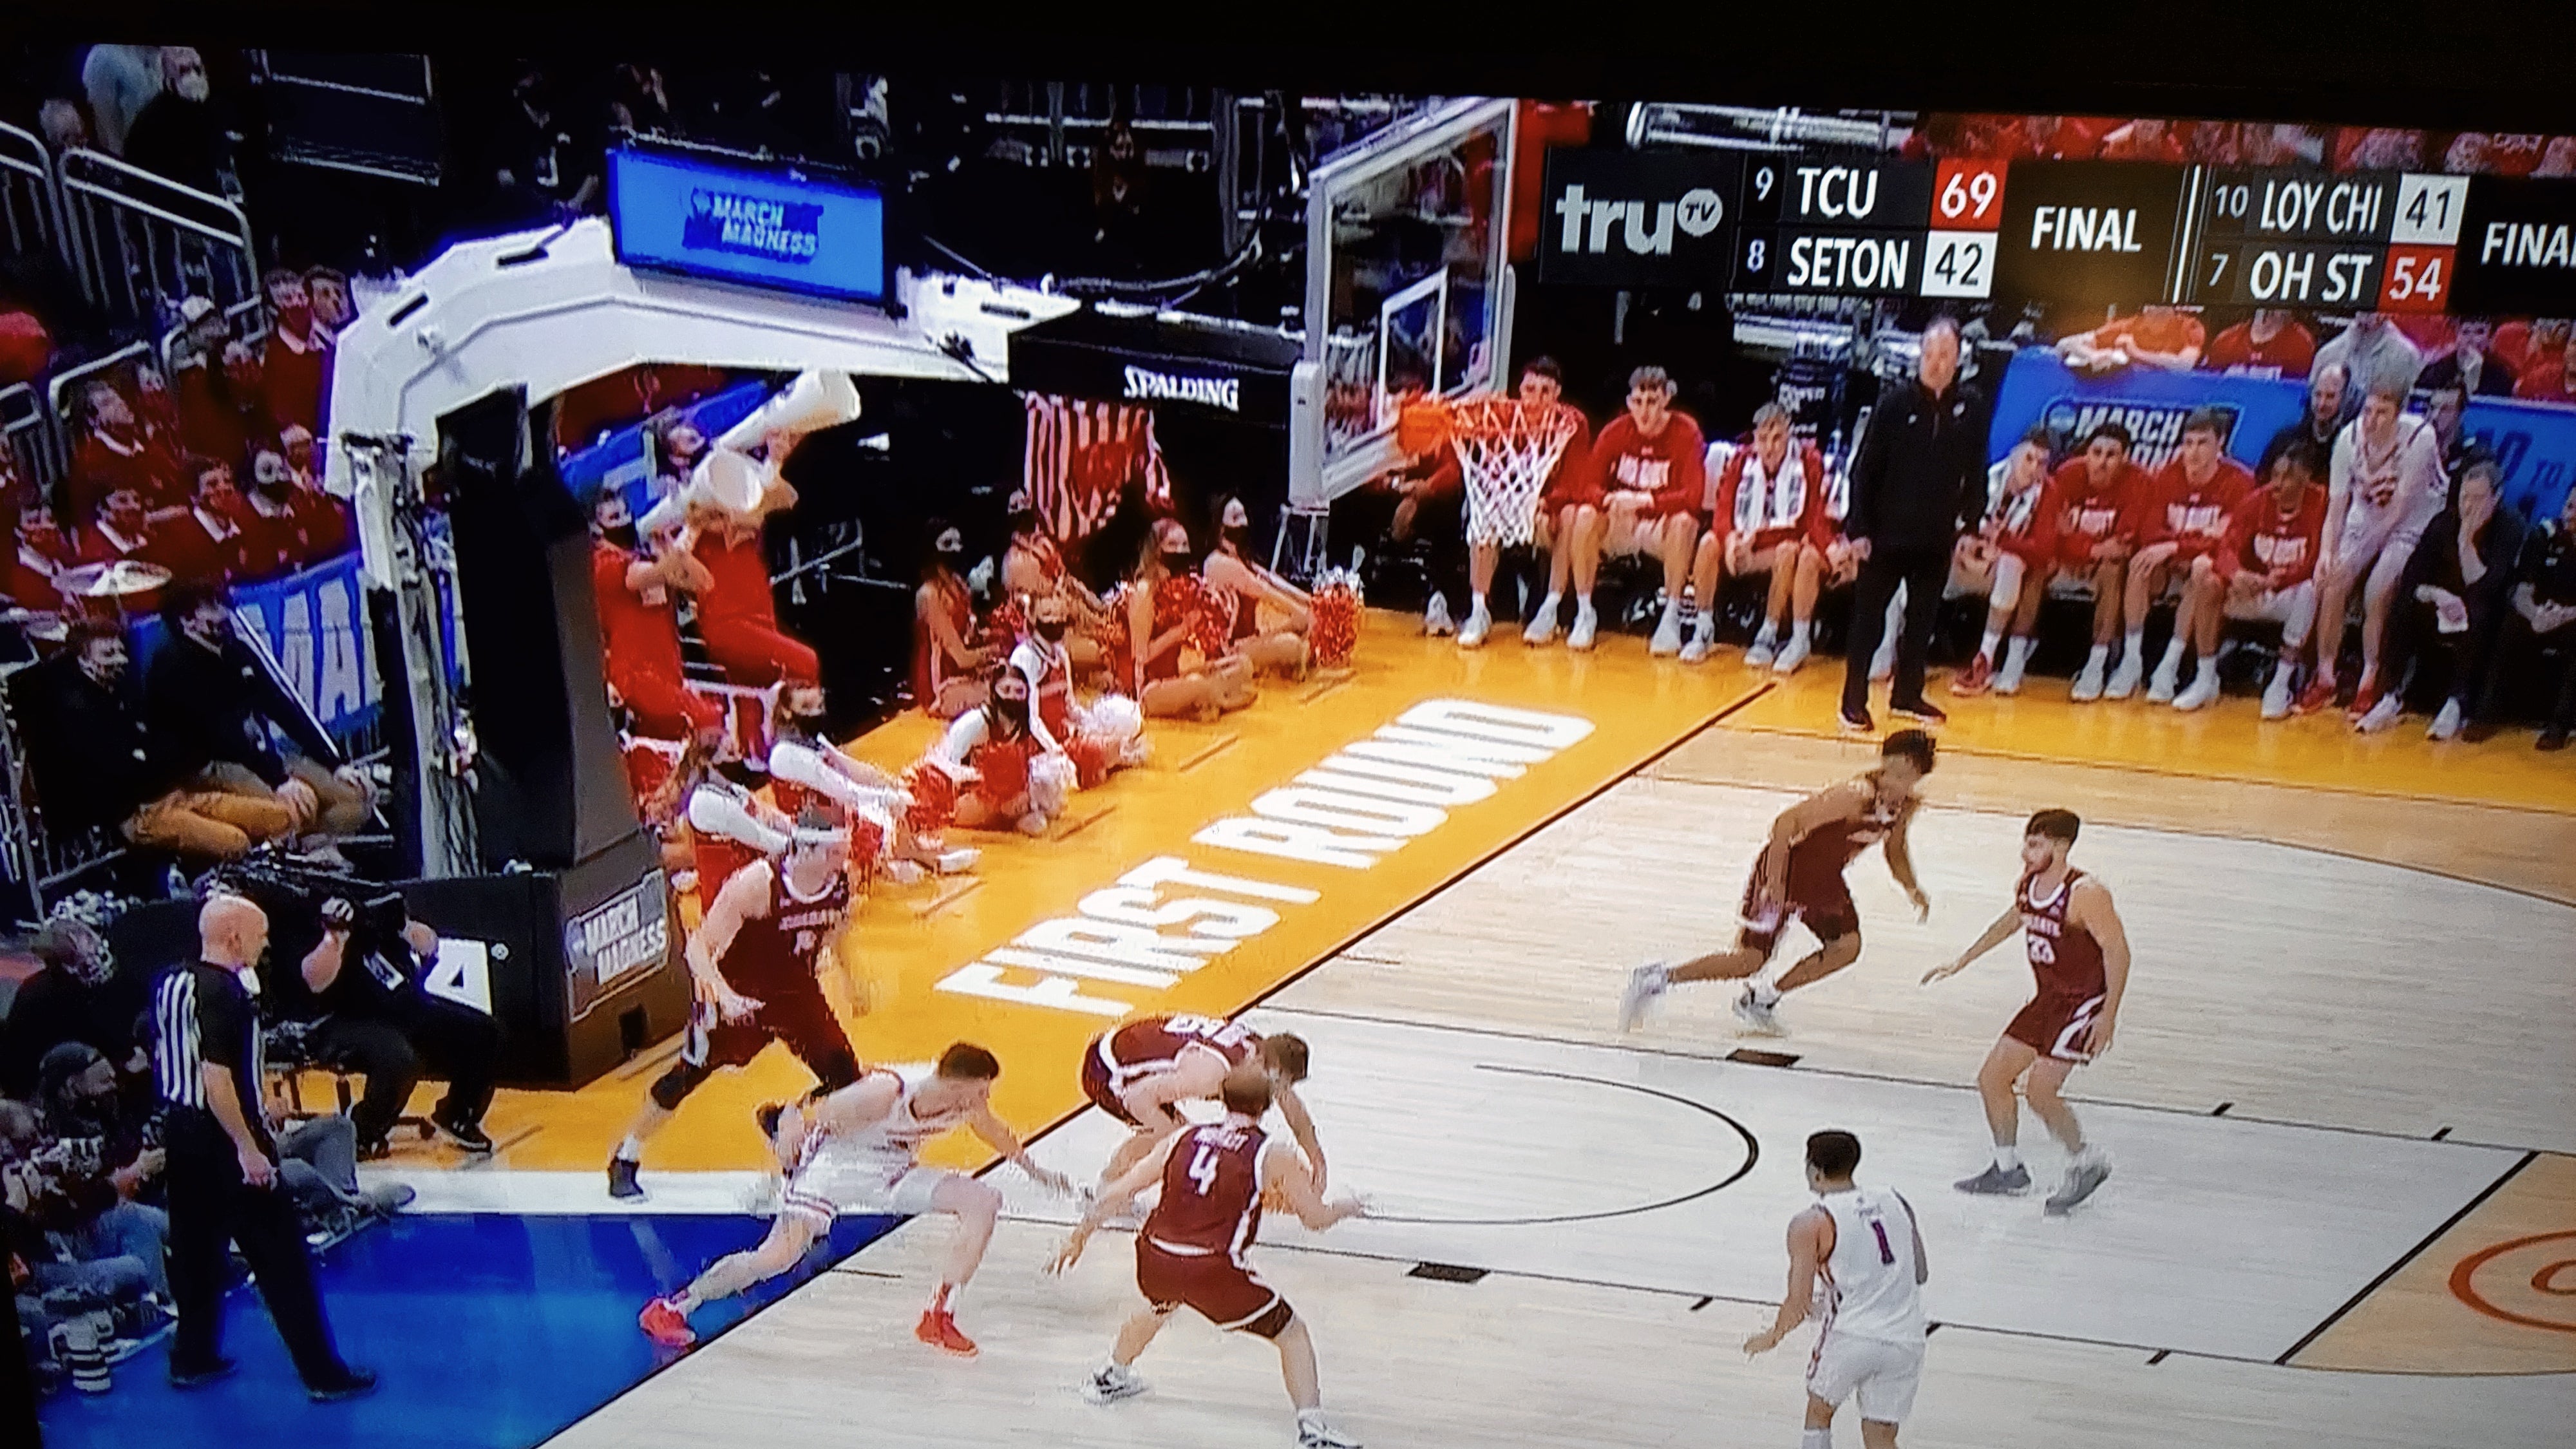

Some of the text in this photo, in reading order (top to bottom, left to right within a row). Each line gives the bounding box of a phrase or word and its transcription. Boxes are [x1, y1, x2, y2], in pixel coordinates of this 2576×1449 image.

[1756, 166, 1997, 219] 9 TCU 69
[2215, 180, 2451, 234] 10 LOY CHI 41
[1555, 184, 1676, 255] tru
[2031, 206, 2143, 252] FINAL
[2481, 222, 2576, 268] FINA
[1747, 237, 1983, 289] 8 SETON 42
[2209, 251, 2442, 302] 7 OH ST 54
[1123, 364, 1239, 412] SPALDING
[1190, 698, 1596, 870] ROUND
[934, 855, 1321, 1017] FIRST
[1189, 1145, 1218, 1196] 4
[1871, 1219, 1895, 1265] 1
